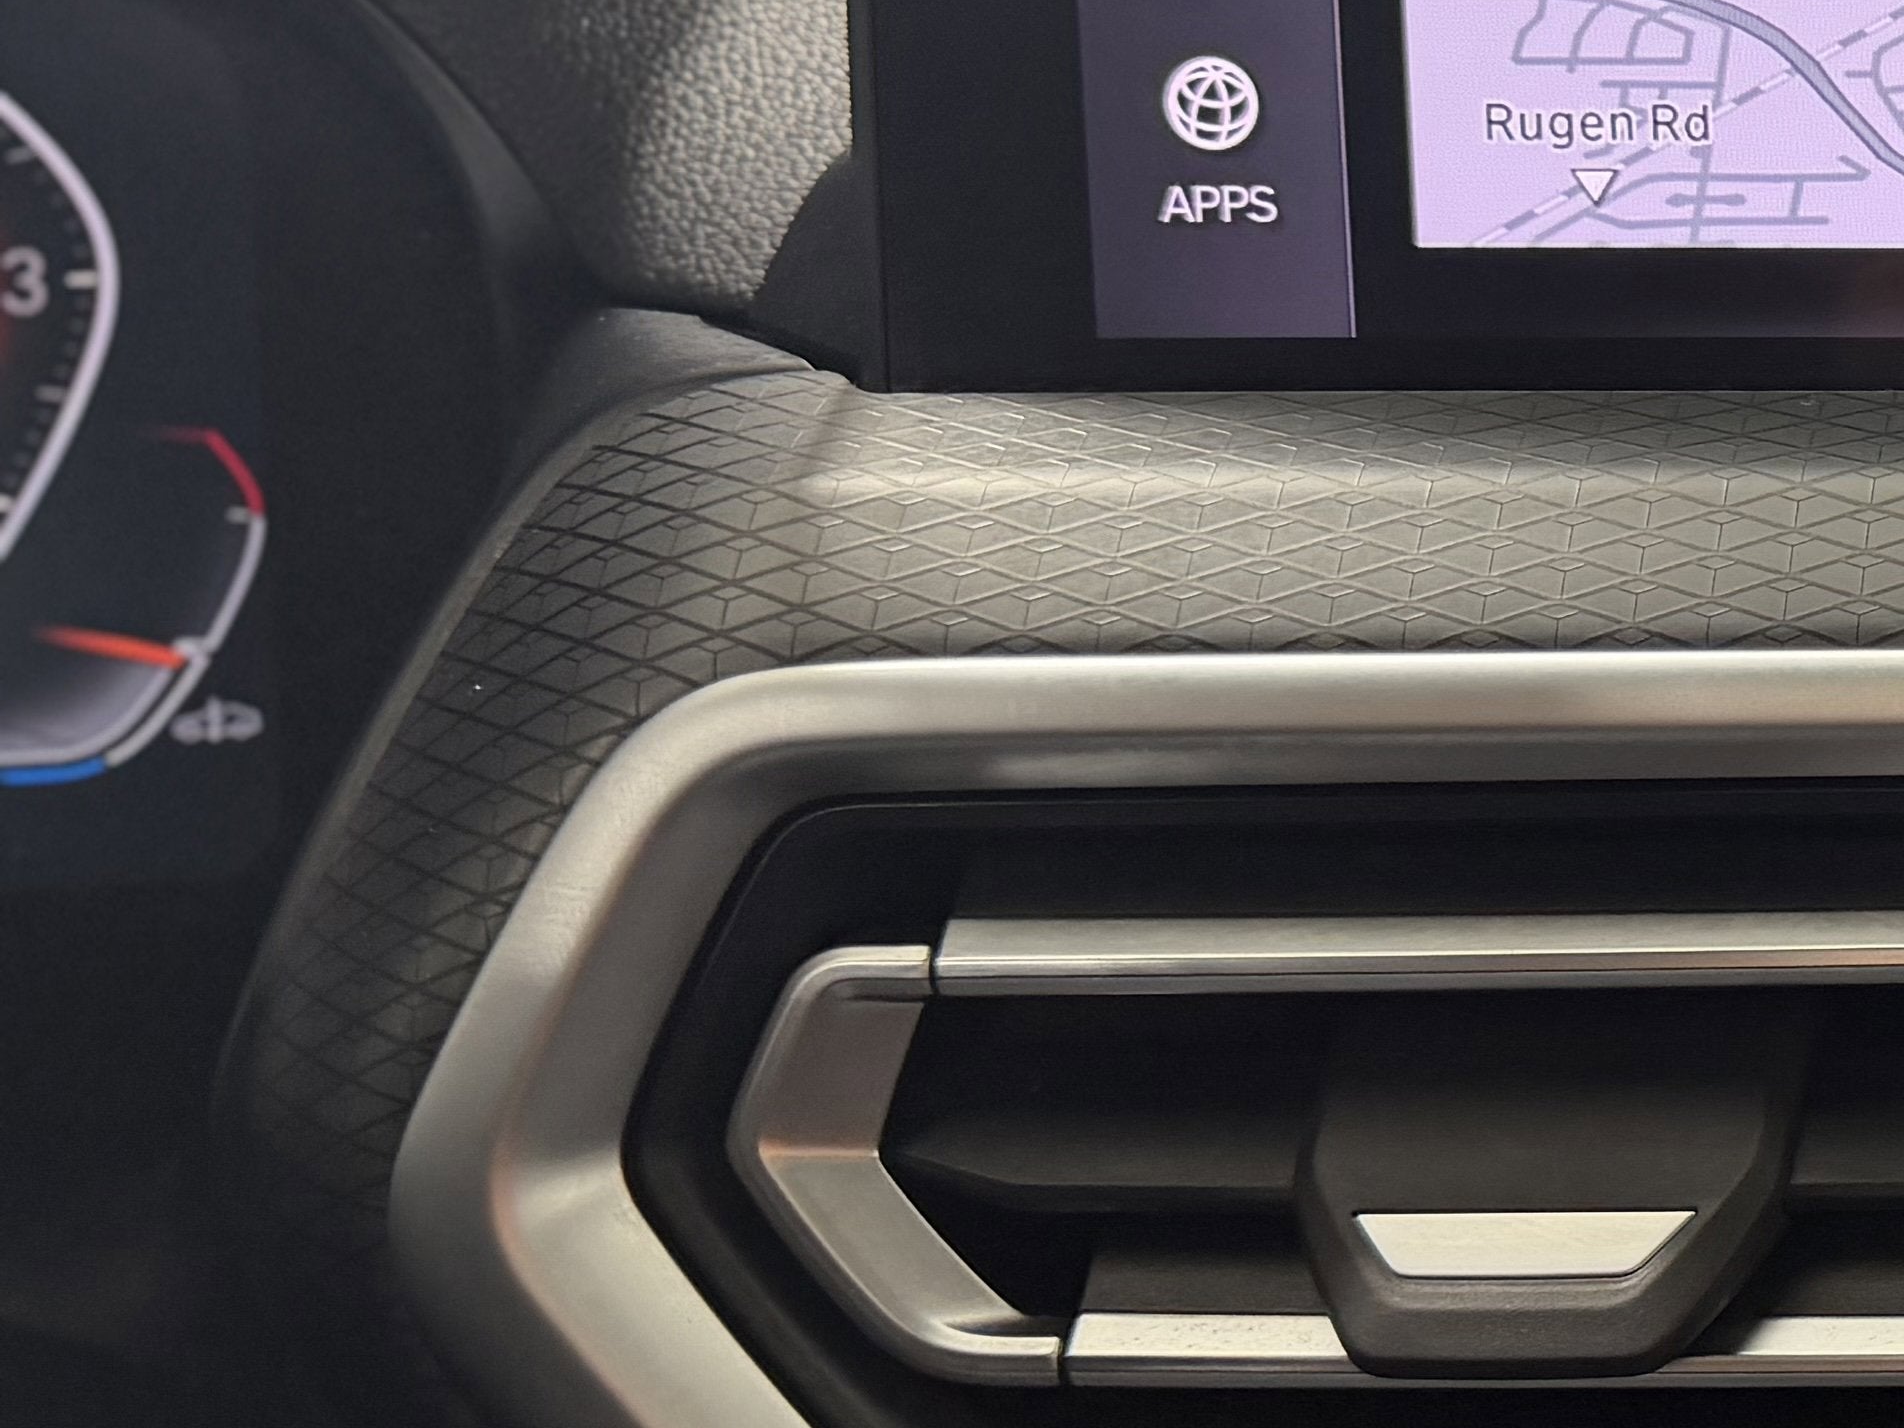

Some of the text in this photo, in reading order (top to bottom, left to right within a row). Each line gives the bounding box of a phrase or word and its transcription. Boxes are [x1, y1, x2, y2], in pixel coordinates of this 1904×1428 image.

[1486, 104, 1711, 148] Rugen Rd
[1158, 185, 1278, 224] APPS
[0, 246, 48, 316] 3
